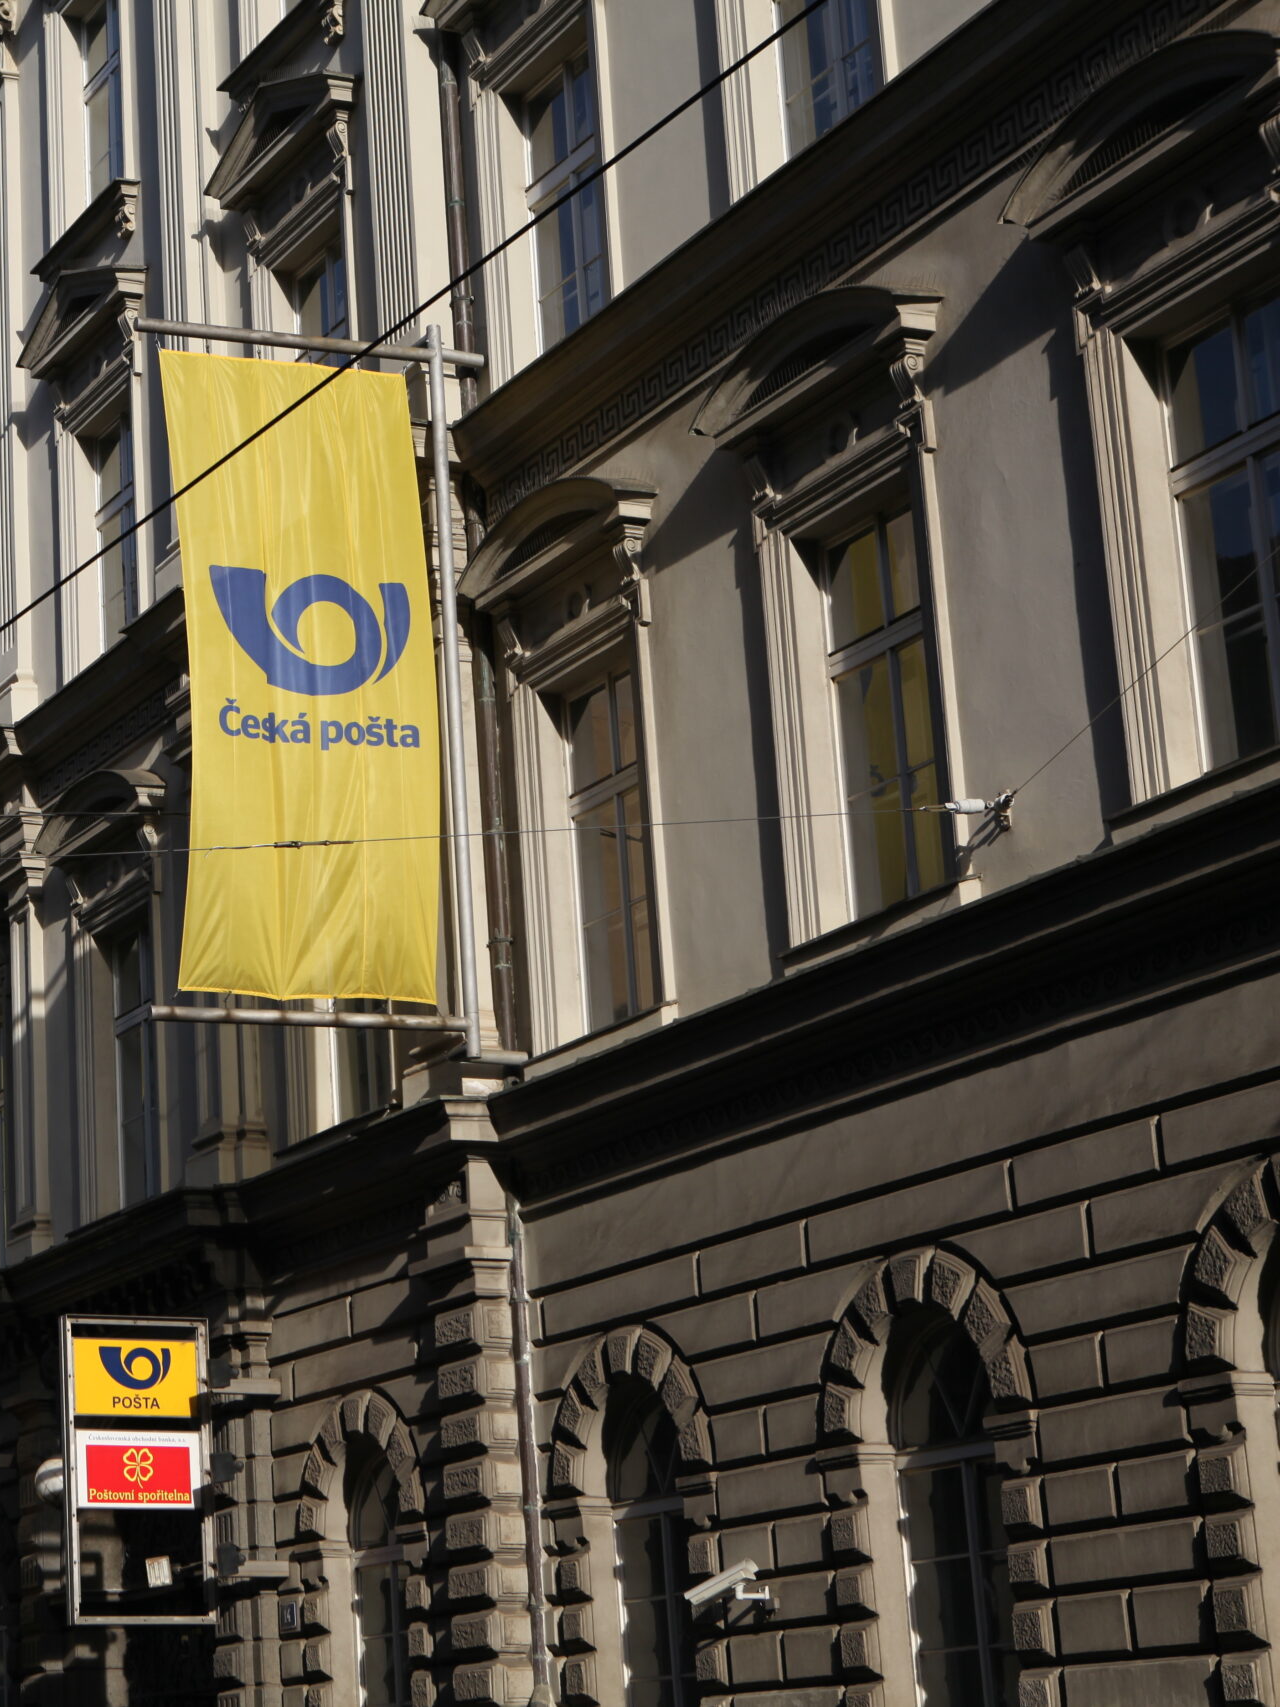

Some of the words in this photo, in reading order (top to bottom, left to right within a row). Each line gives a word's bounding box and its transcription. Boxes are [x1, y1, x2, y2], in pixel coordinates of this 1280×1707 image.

[218, 697, 311, 744] Česká
[320, 715, 420, 751] pošta
[112, 1394, 160, 1409] POŠTA
[89, 1488, 135, 1501] Poštovní
[137, 1488, 190, 1504] spořitelna
